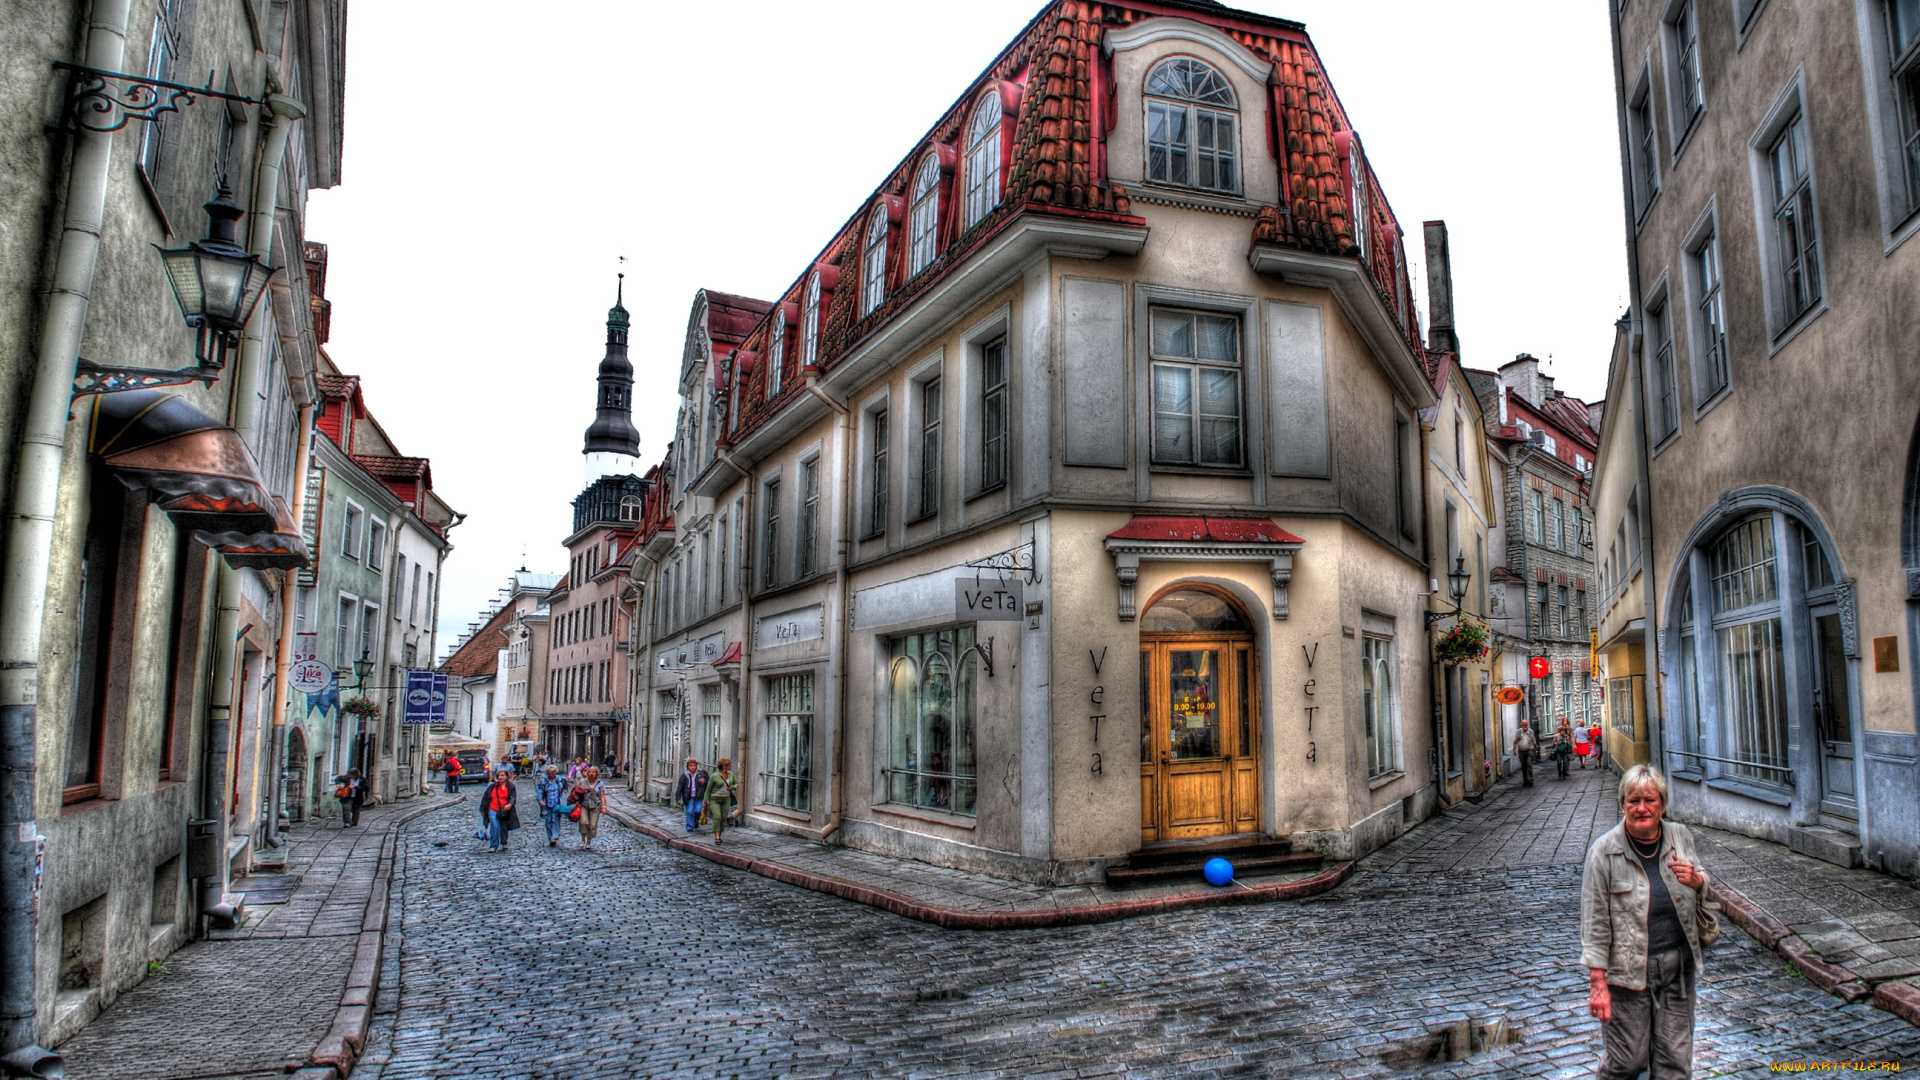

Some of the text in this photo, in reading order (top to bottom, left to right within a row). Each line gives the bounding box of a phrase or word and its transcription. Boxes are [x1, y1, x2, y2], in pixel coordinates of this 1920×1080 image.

[964, 590, 1016, 612] VeTa
[776, 621, 800, 639] VeTa
[1089, 645, 1108, 776] VeTa
[1174, 703, 1190, 711] 9.00
[1196, 702, 1216, 710] 19.00
[1301, 642, 1320, 763] VeTa
